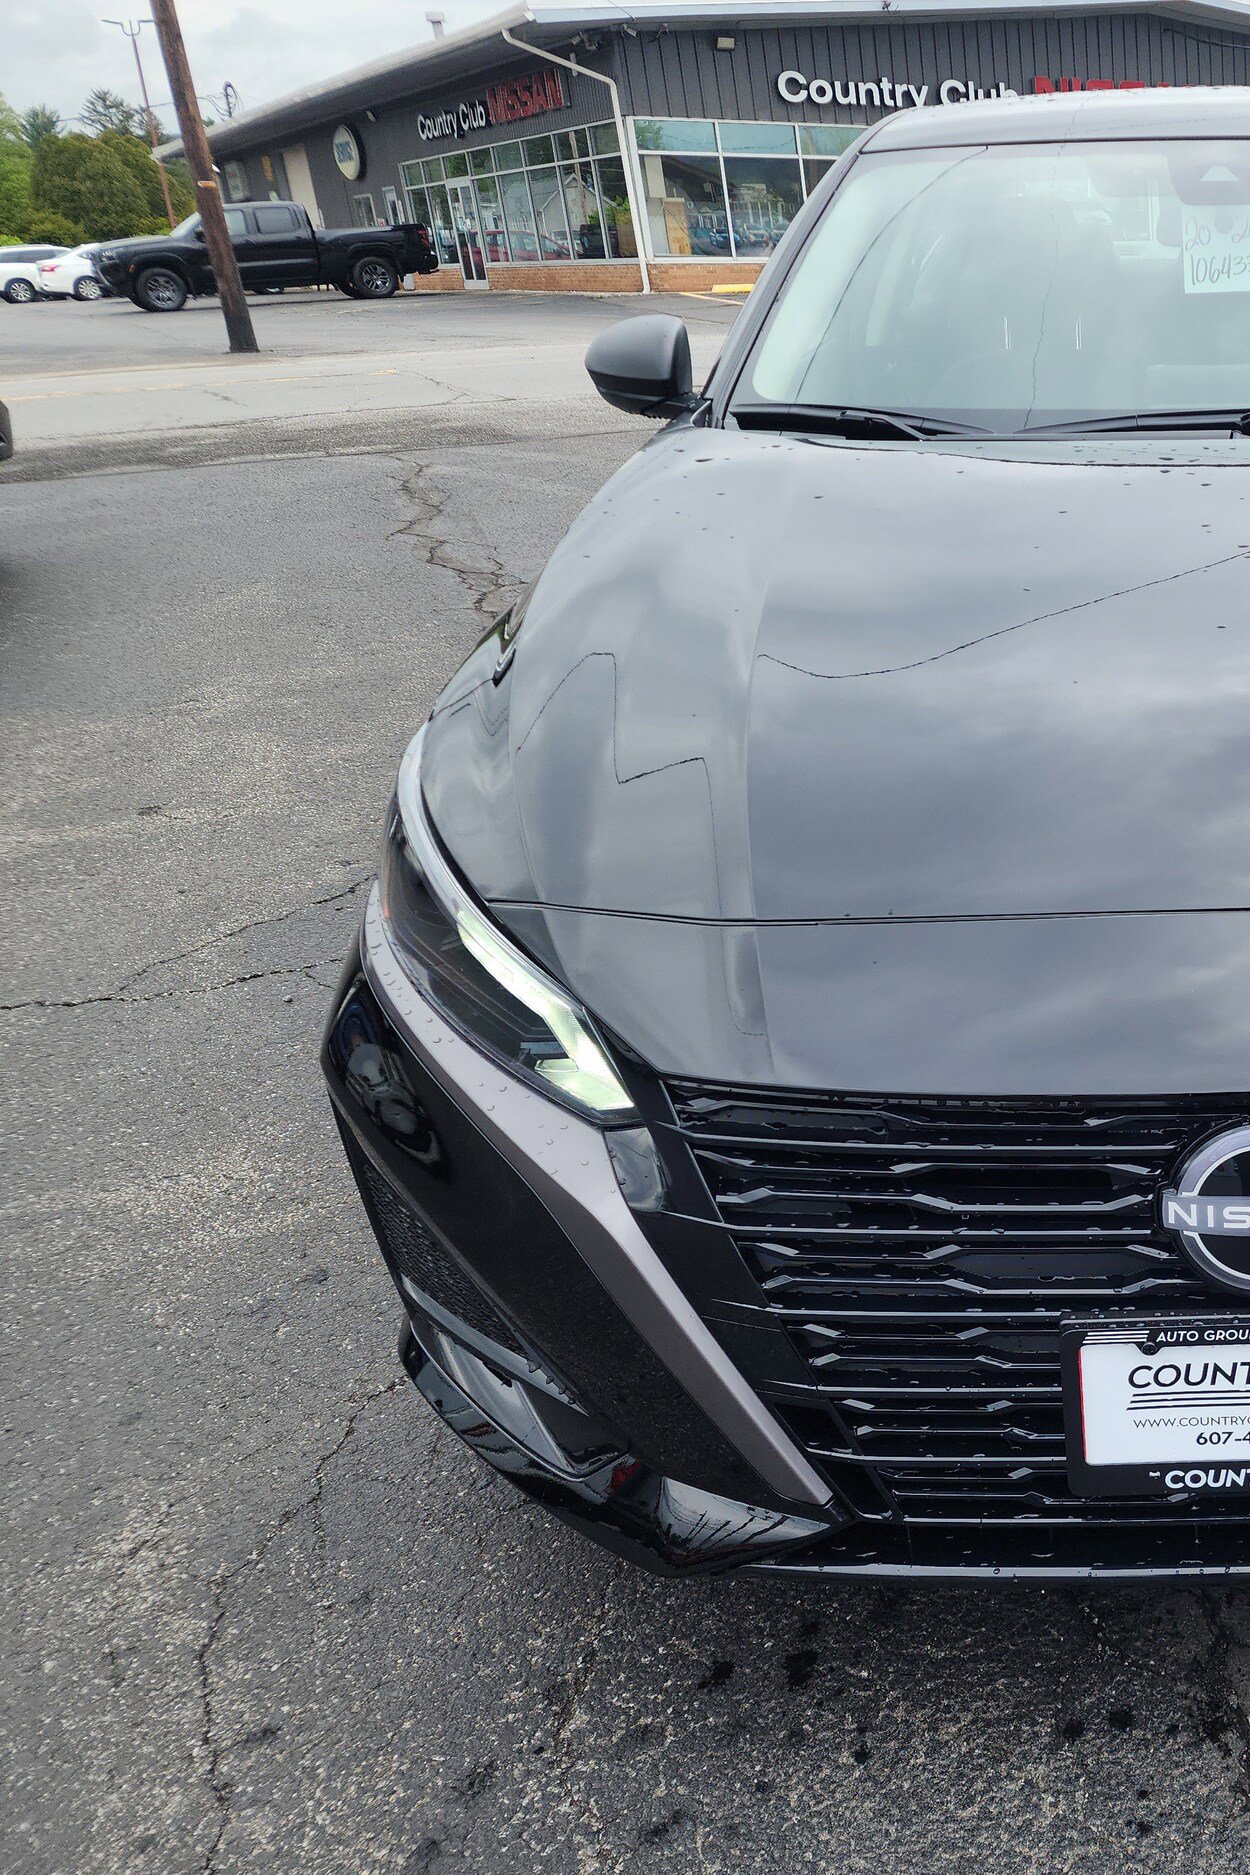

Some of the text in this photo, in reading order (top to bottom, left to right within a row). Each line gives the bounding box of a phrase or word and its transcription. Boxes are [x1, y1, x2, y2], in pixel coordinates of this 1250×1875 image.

[417, 65, 565, 141] Country Club NISSAN
[777, 70, 929, 108] Country
[1155, 1330, 1199, 1343] AUTO
